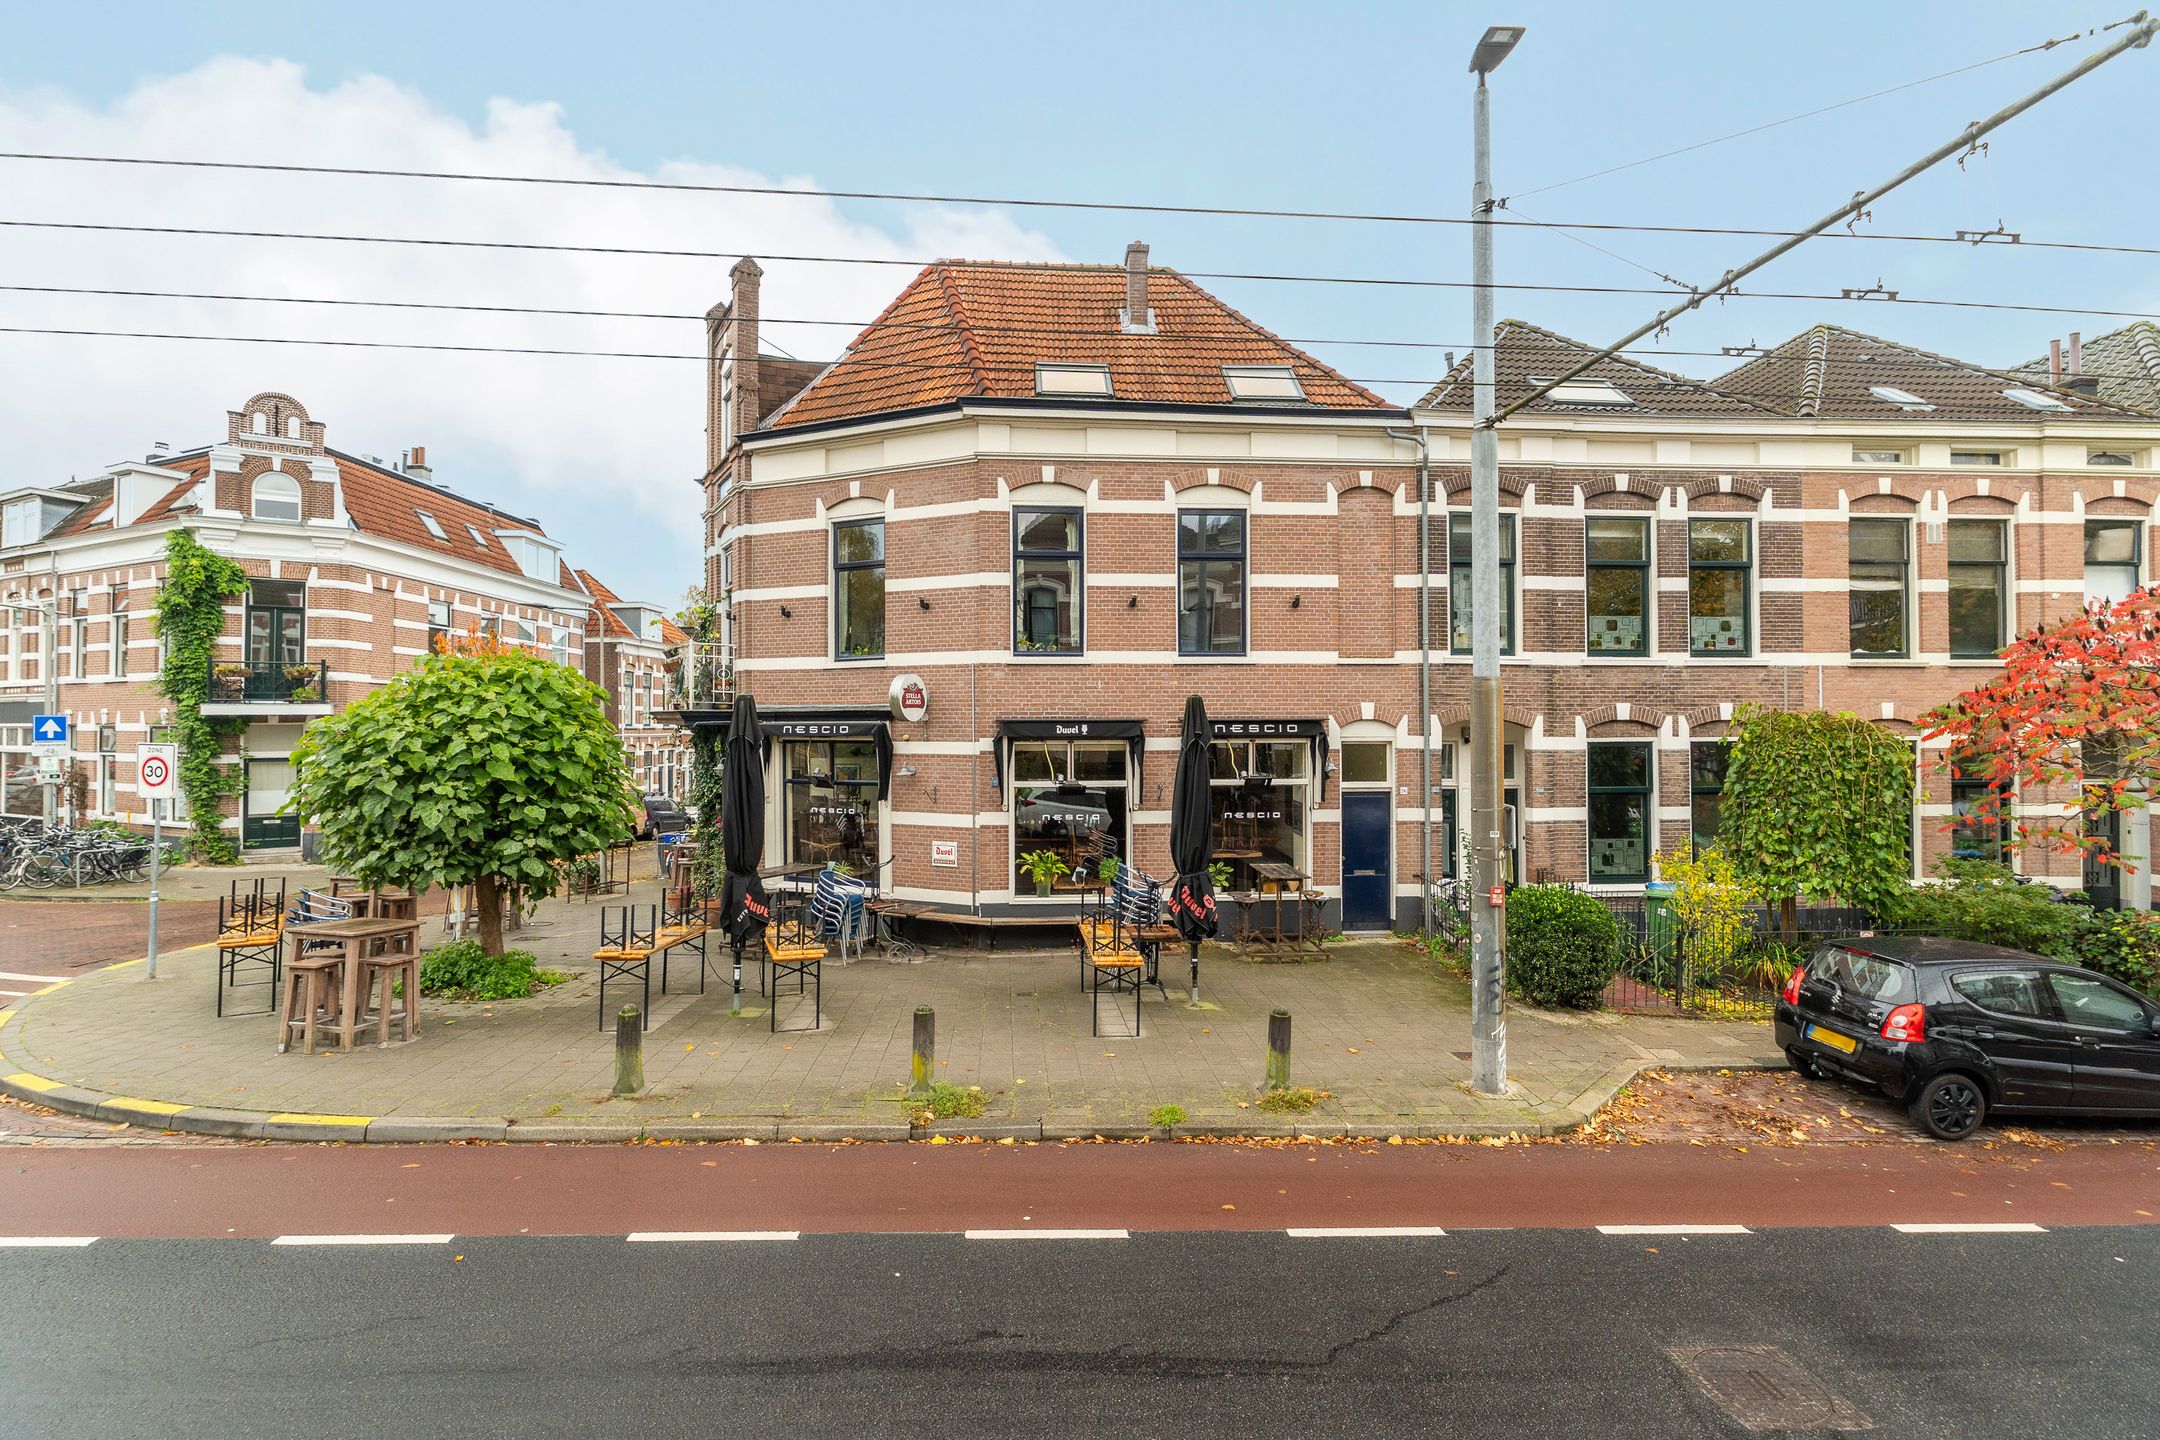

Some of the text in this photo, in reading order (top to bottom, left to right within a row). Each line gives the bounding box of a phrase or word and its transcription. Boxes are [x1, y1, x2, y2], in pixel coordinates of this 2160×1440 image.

[1055, 724, 1079, 734] Duvel
[146, 765, 163, 778] 30
[1180, 885, 1207, 920] Duvel
